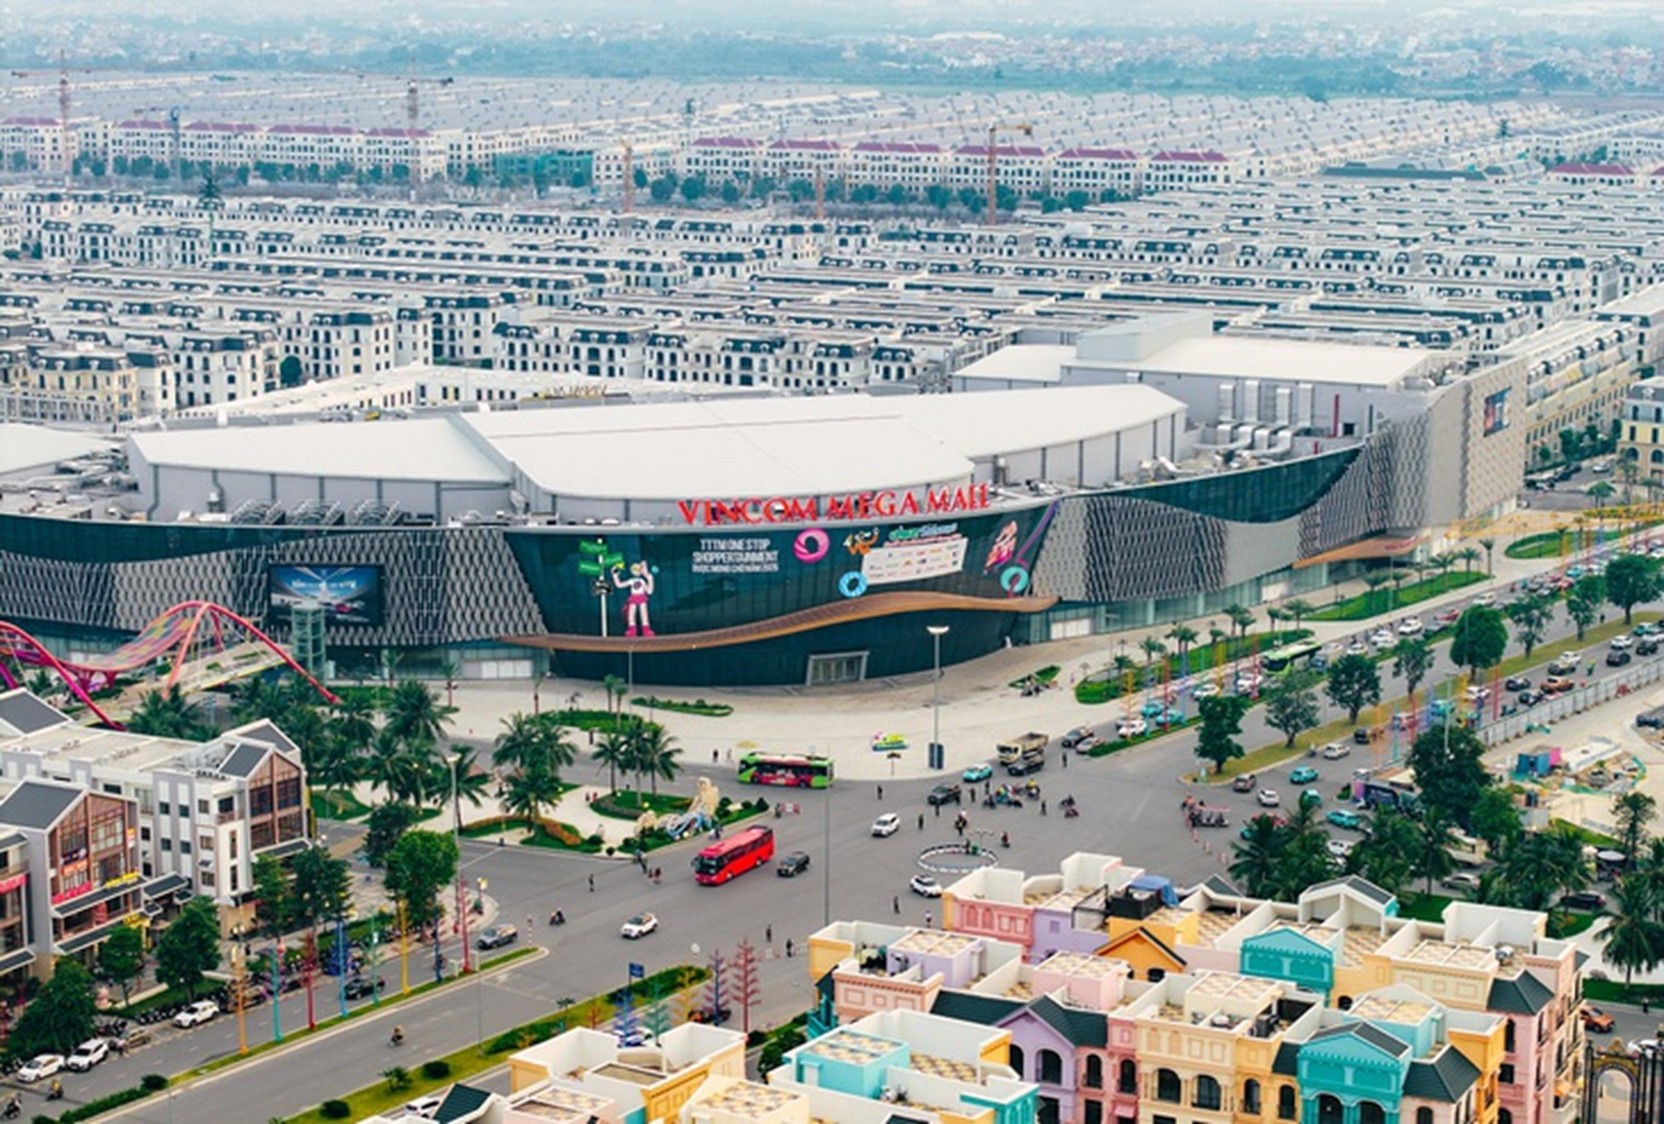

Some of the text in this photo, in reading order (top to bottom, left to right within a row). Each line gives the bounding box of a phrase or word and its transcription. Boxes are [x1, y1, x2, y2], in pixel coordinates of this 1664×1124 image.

[678, 482, 991, 526] VINCOM MEGA MALL
[747, 538, 771, 550] STOP
